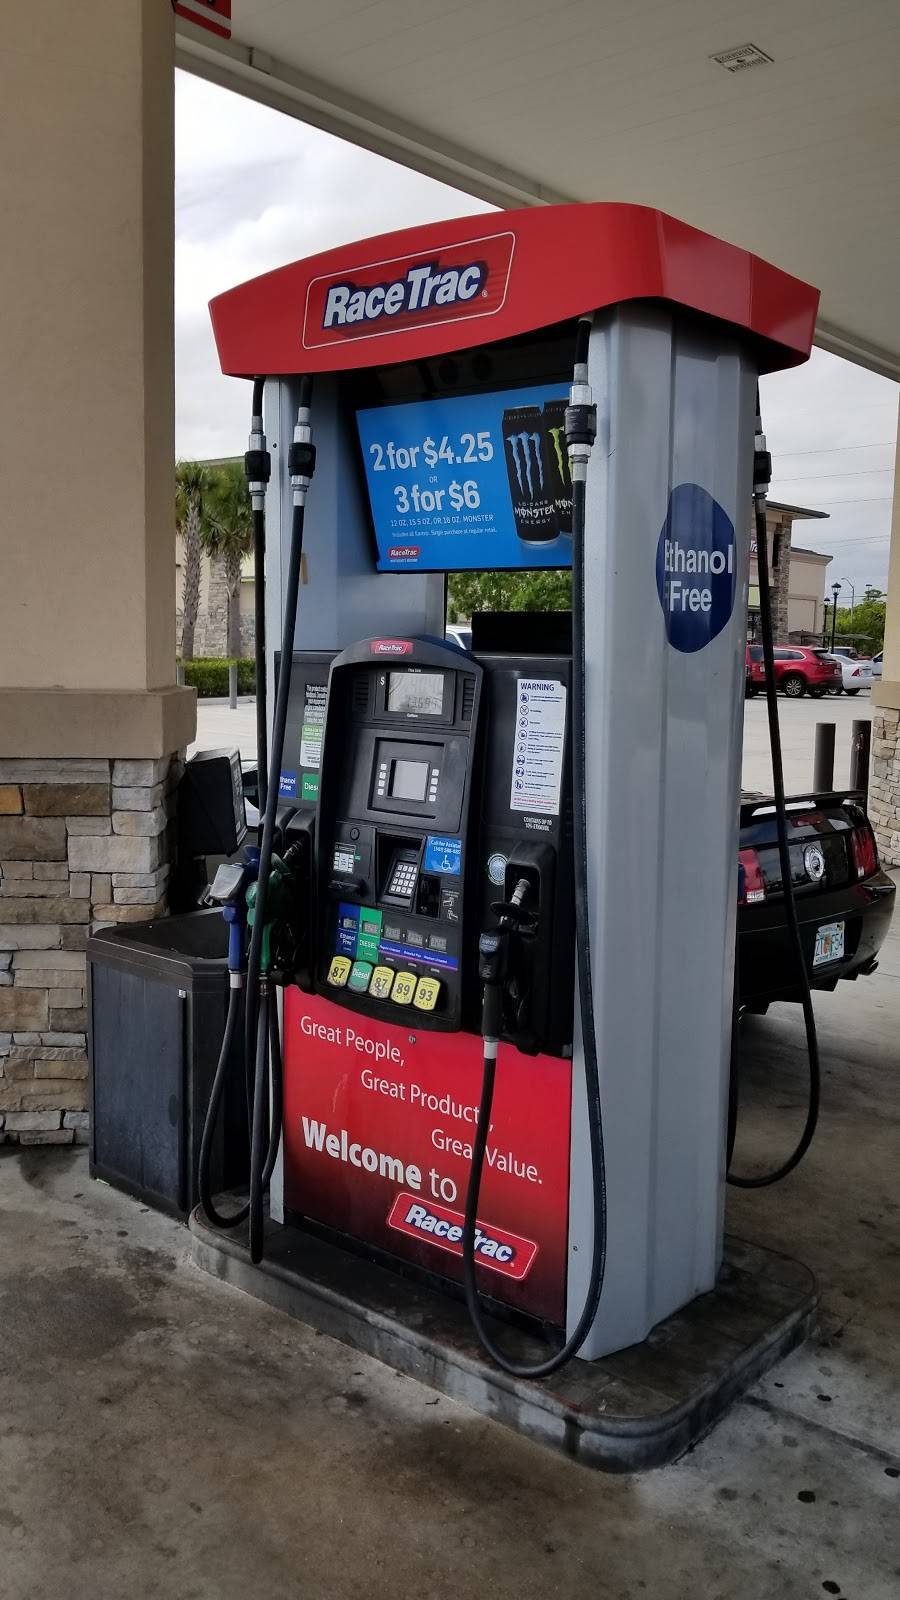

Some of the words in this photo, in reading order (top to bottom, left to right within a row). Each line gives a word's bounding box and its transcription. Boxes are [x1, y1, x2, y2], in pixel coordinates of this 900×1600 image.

[323, 265, 482, 328] RaceTrac
[370, 443, 386, 471] 2
[386, 442, 420, 470] for
[423, 432, 494, 469] $4.25
[429, 475, 438, 483] OR
[394, 485, 410, 513] 3
[411, 484, 445, 512] for
[448, 480, 481, 511] $6
[462, 514, 494, 523] MONSTER
[514, 504, 555, 518] MONSTER
[664, 539, 733, 574] Ethanol
[669, 580, 712, 612] Free
[520, 682, 555, 691] WARNING
[280, 775, 296, 784] thanol
[332, 966, 346, 979] 87
[351, 967, 369, 979] Diesel
[396, 983, 411, 996] 89
[418, 988, 433, 1001] 93
[301, 1015, 341, 1045] Great
[346, 1029, 405, 1067] People,
[360, 1069, 405, 1101] Great
[410, 1084, 494, 1131] Product,
[301, 1116, 422, 1190] Welcome
[428, 1168, 457, 1202] to
[431, 1128, 473, 1160] Grea
[484, 1145, 542, 1184] Value.
